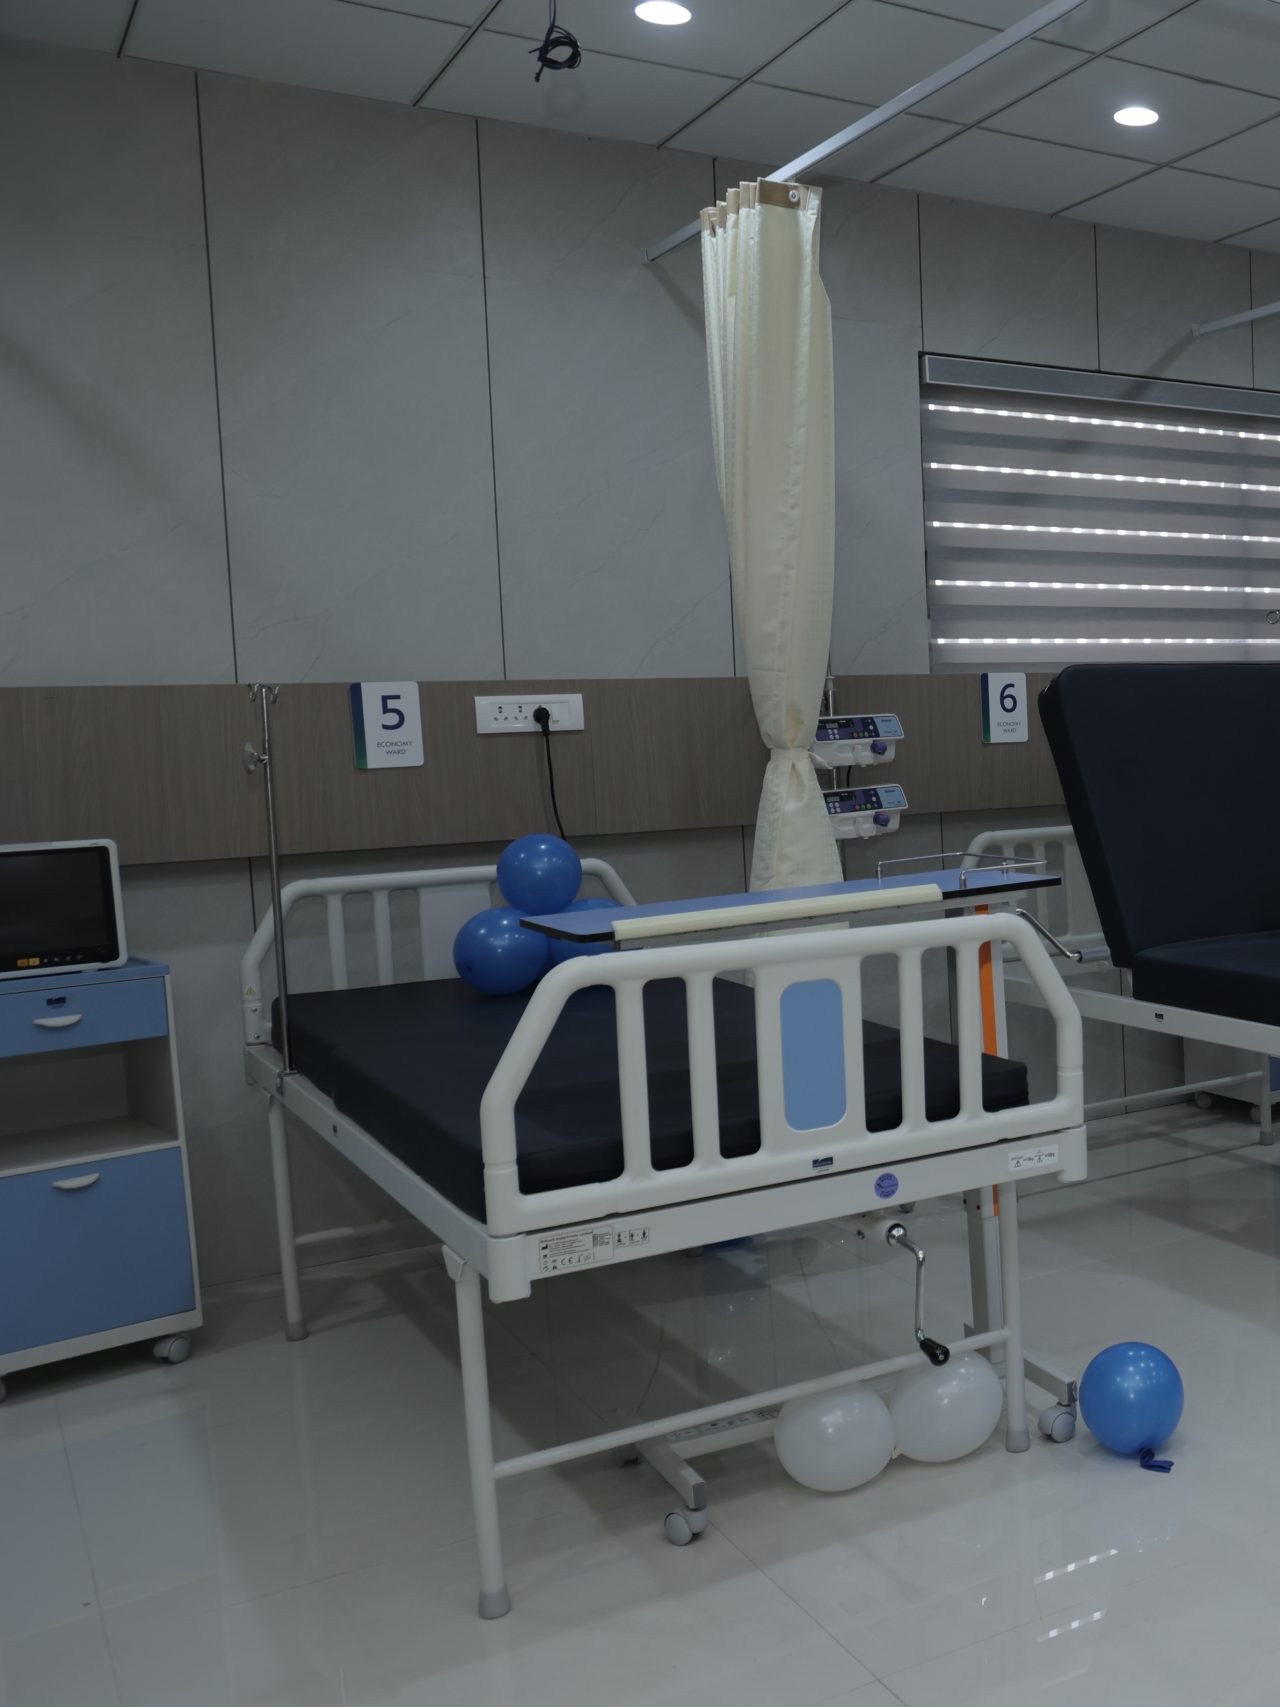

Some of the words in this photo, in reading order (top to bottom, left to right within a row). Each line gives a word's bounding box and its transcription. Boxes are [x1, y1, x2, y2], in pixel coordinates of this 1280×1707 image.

[381, 694, 405, 730] 5
[999, 683, 1017, 713] 6
[376, 740, 412, 748] ECONOMY
